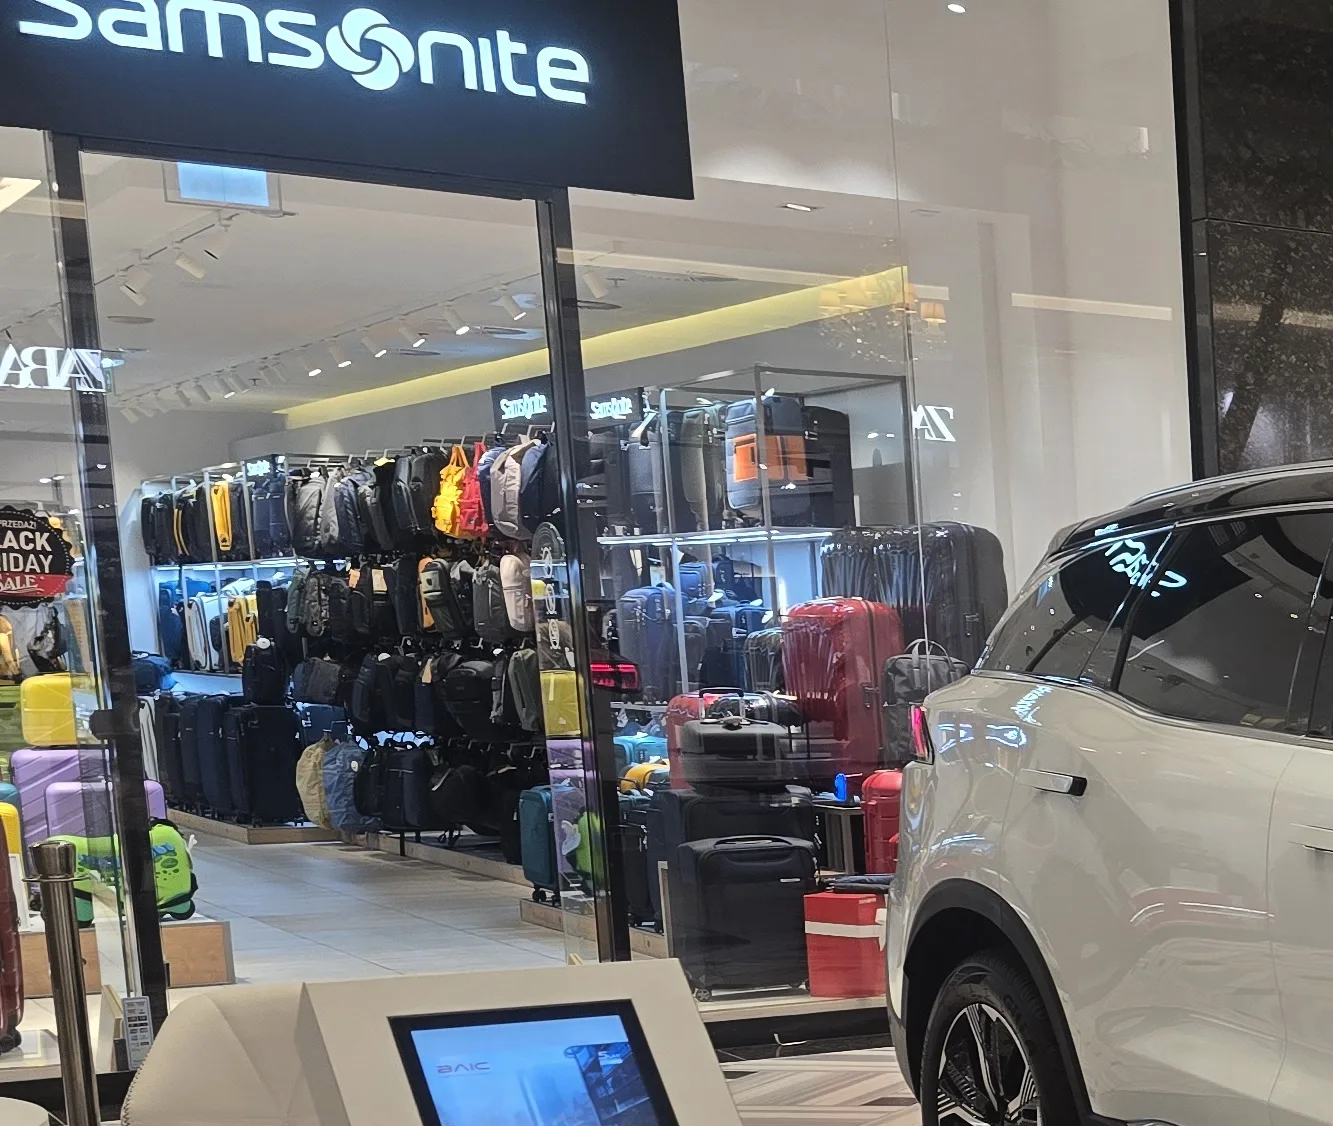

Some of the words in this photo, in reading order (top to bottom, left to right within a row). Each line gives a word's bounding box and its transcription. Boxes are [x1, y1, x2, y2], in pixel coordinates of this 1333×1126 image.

[0, 530, 52, 551] ACK
[0, 552, 53, 573] IDAY
[436, 1061, 491, 1074] BAIC
